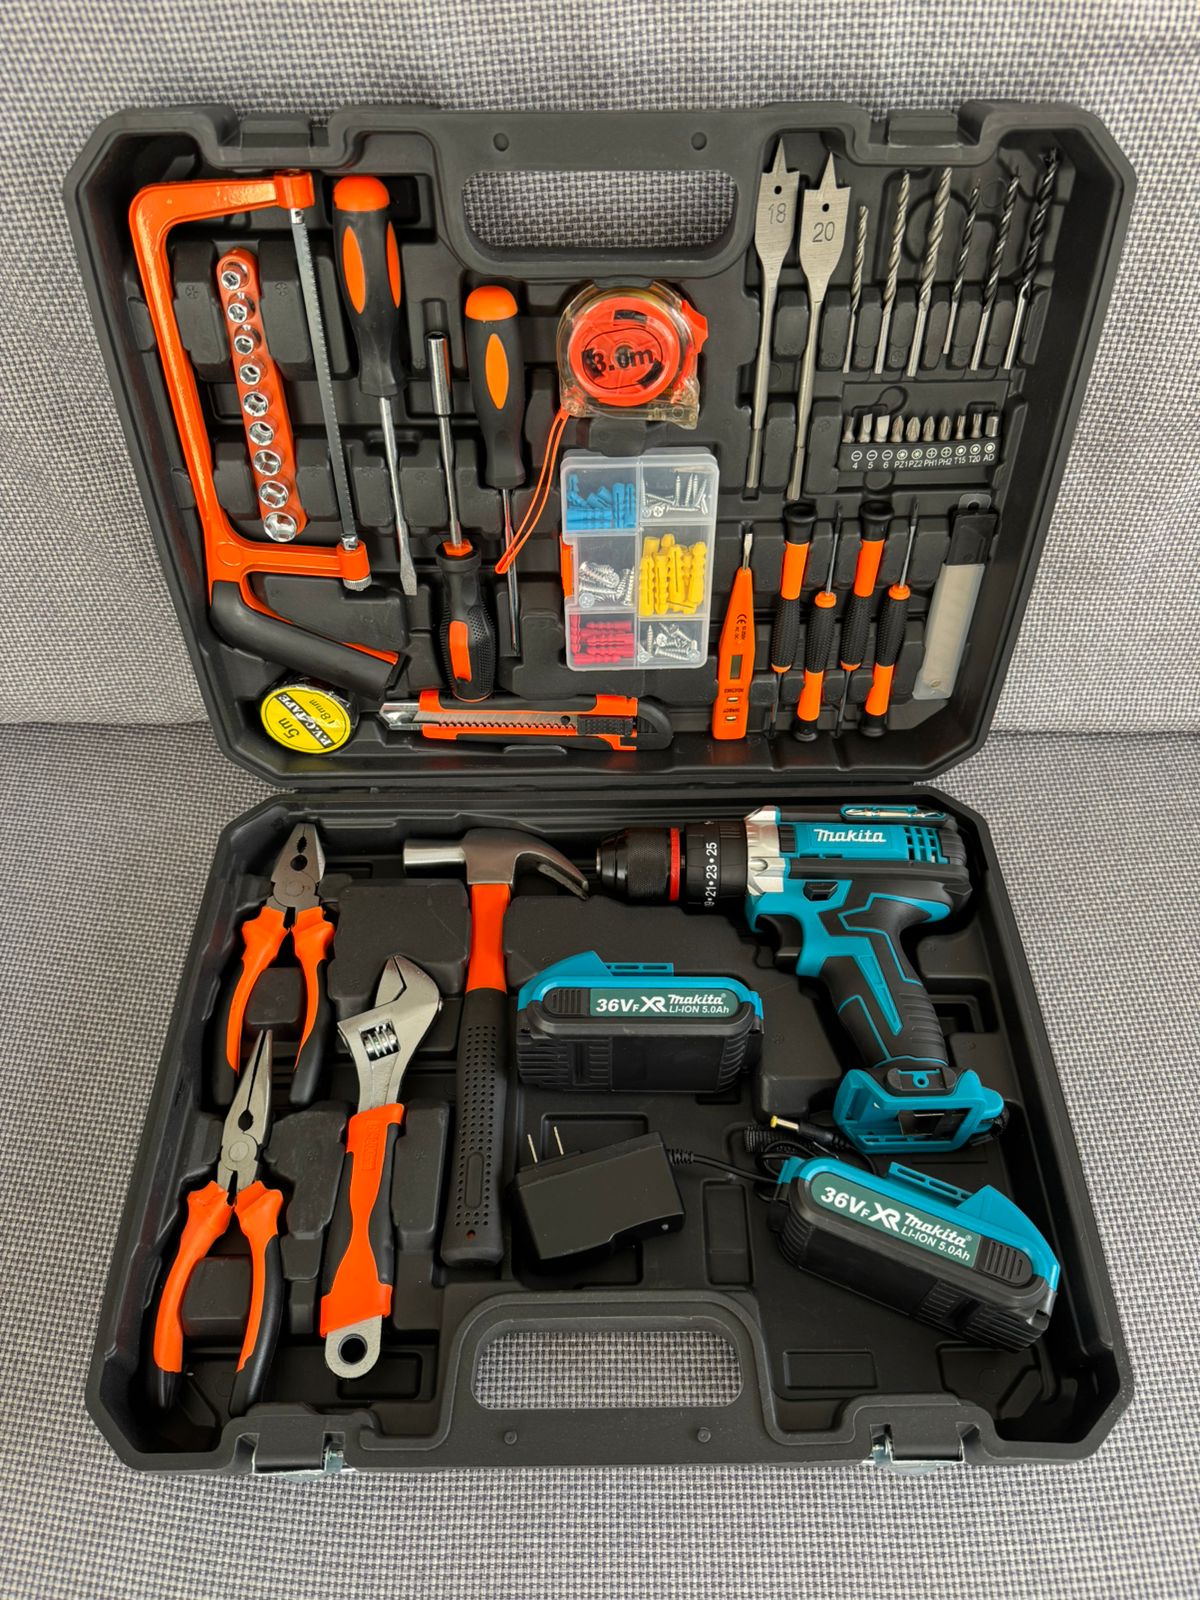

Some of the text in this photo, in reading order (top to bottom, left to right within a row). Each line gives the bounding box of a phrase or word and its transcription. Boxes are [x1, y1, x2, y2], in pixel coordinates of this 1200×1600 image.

[769, 203, 786, 224] 18
[812, 221, 835, 243] 20
[867, 461, 874, 469] 5
[883, 461, 889, 469] 6
[894, 460, 908, 468] PZ1
[909, 459, 923, 468] PZ2
[924, 459, 937, 467] PH1
[938, 457, 953, 466] PH2
[954, 456, 967, 464] T15
[969, 455, 981, 463] T20
[983, 453, 995, 462] AD
[278, 694, 308, 721] TAPE
[309, 698, 335, 725] 18mm
[278, 717, 300, 739] 5m
[705, 842, 717, 859] 25
[705, 865, 717, 880] 23
[705, 886, 717, 898] 21
[669, 1005, 730, 1014] LI-ION 5.0Ah
[900, 1226, 970, 1261] LI-ION 5.0Ah
